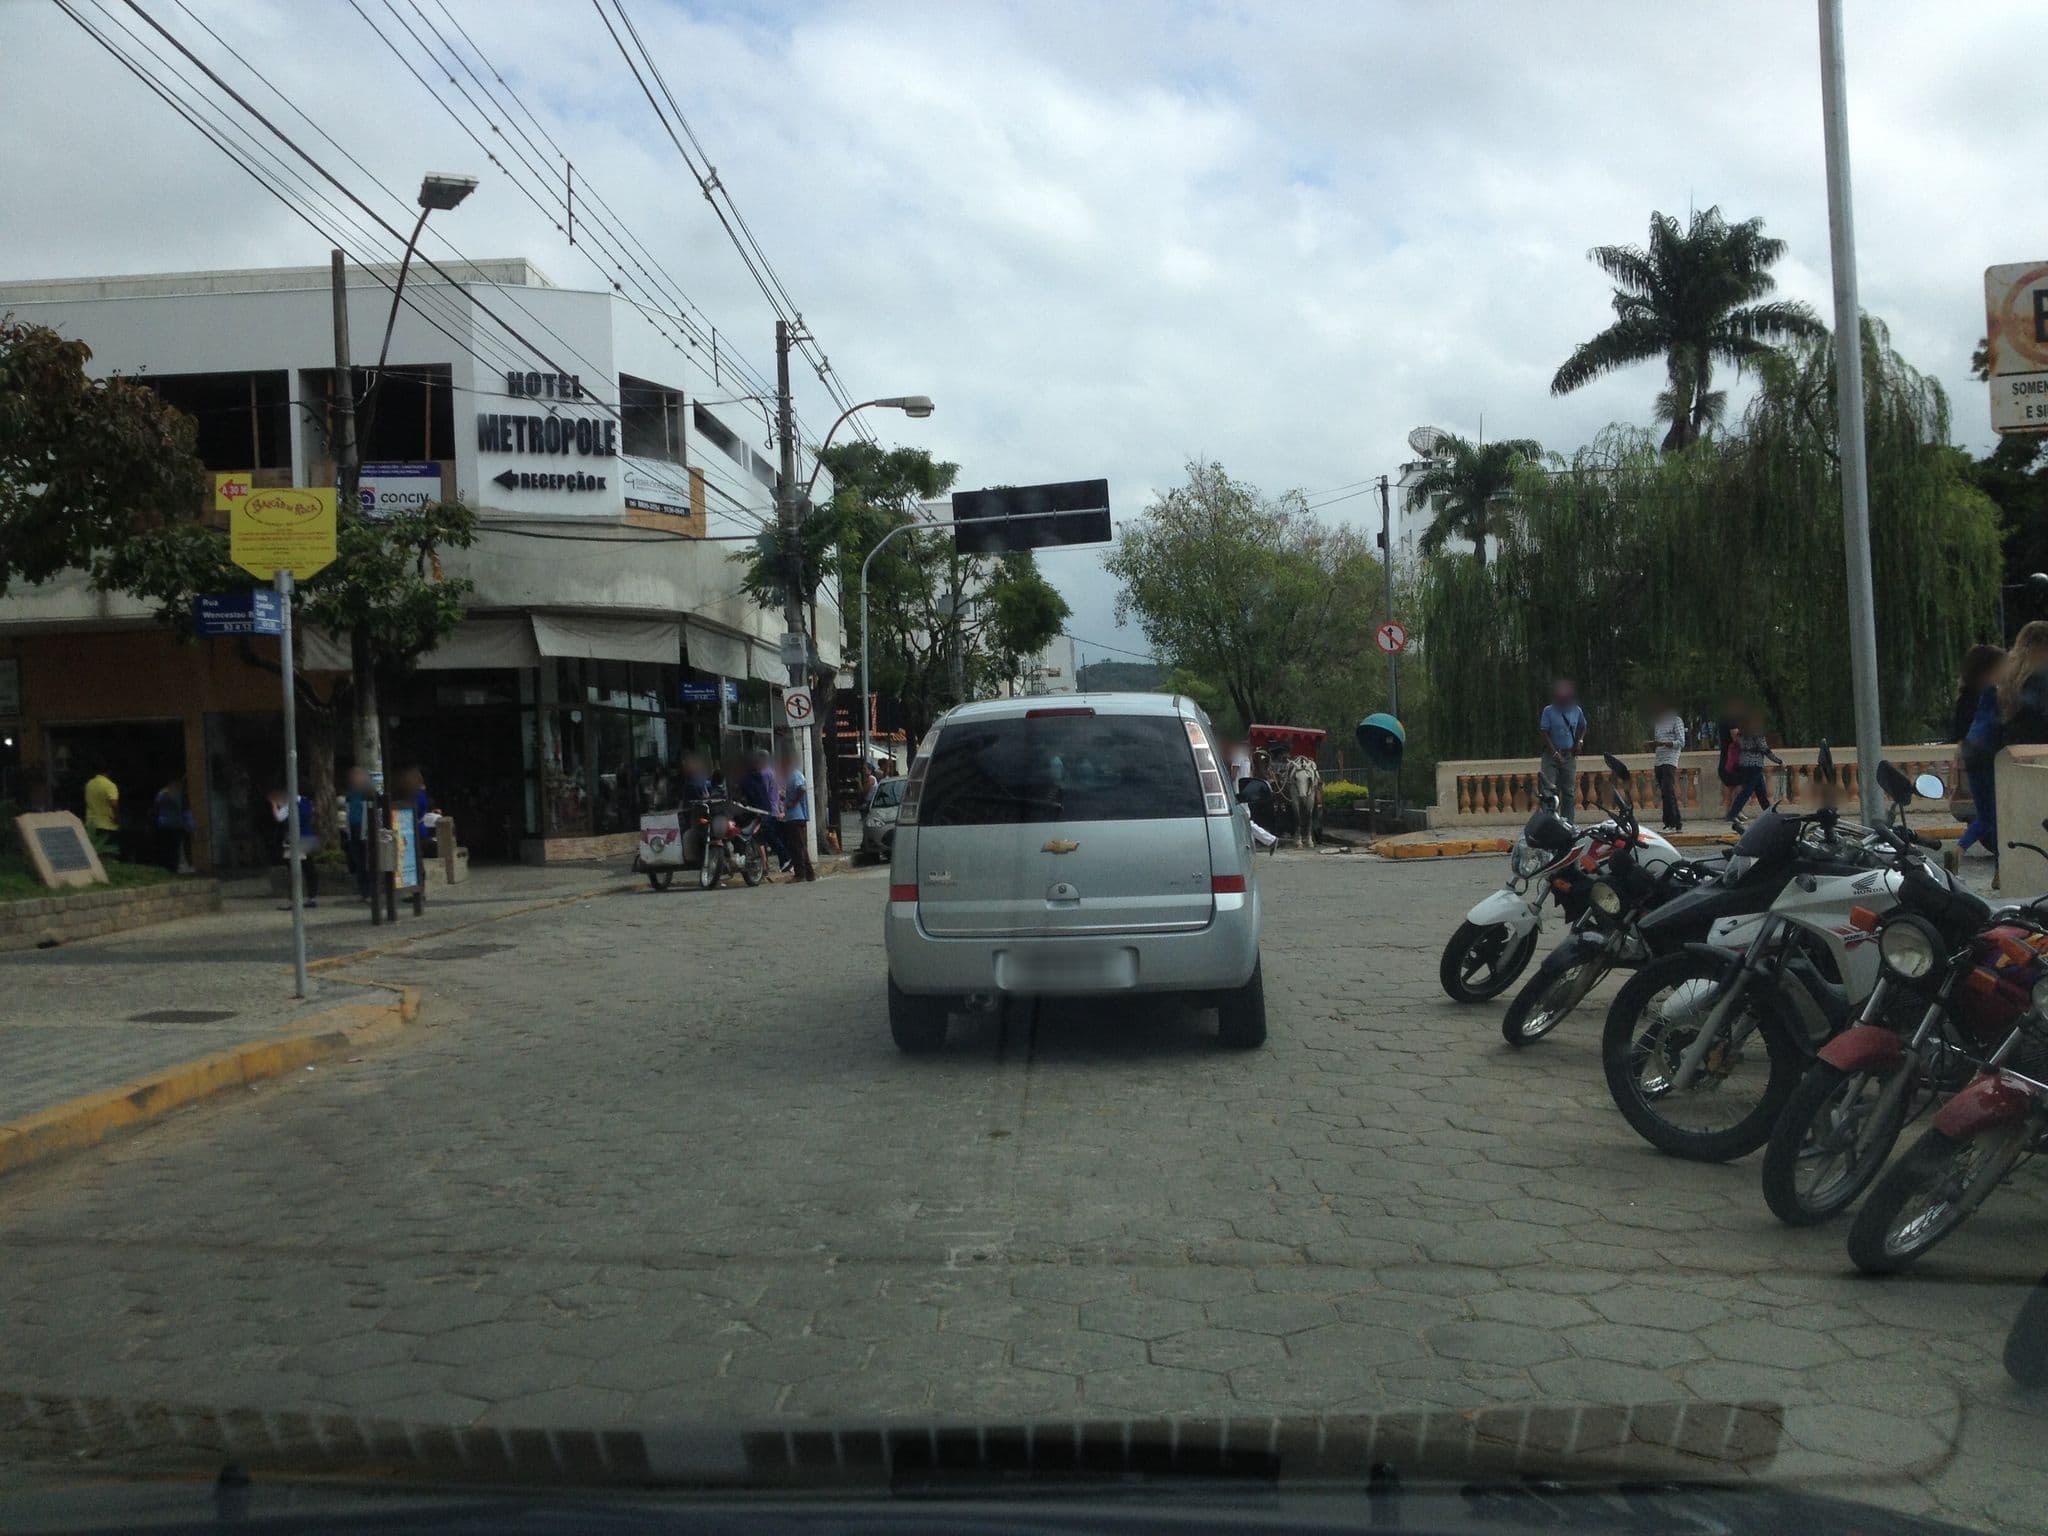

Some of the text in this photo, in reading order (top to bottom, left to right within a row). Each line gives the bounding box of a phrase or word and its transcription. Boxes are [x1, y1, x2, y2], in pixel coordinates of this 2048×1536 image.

[507, 371, 584, 399] HOTEL
[2026, 405, 2033, 418] E
[477, 406, 617, 457] METRÓPOLE
[1853, 887, 1885, 895] HONDA
